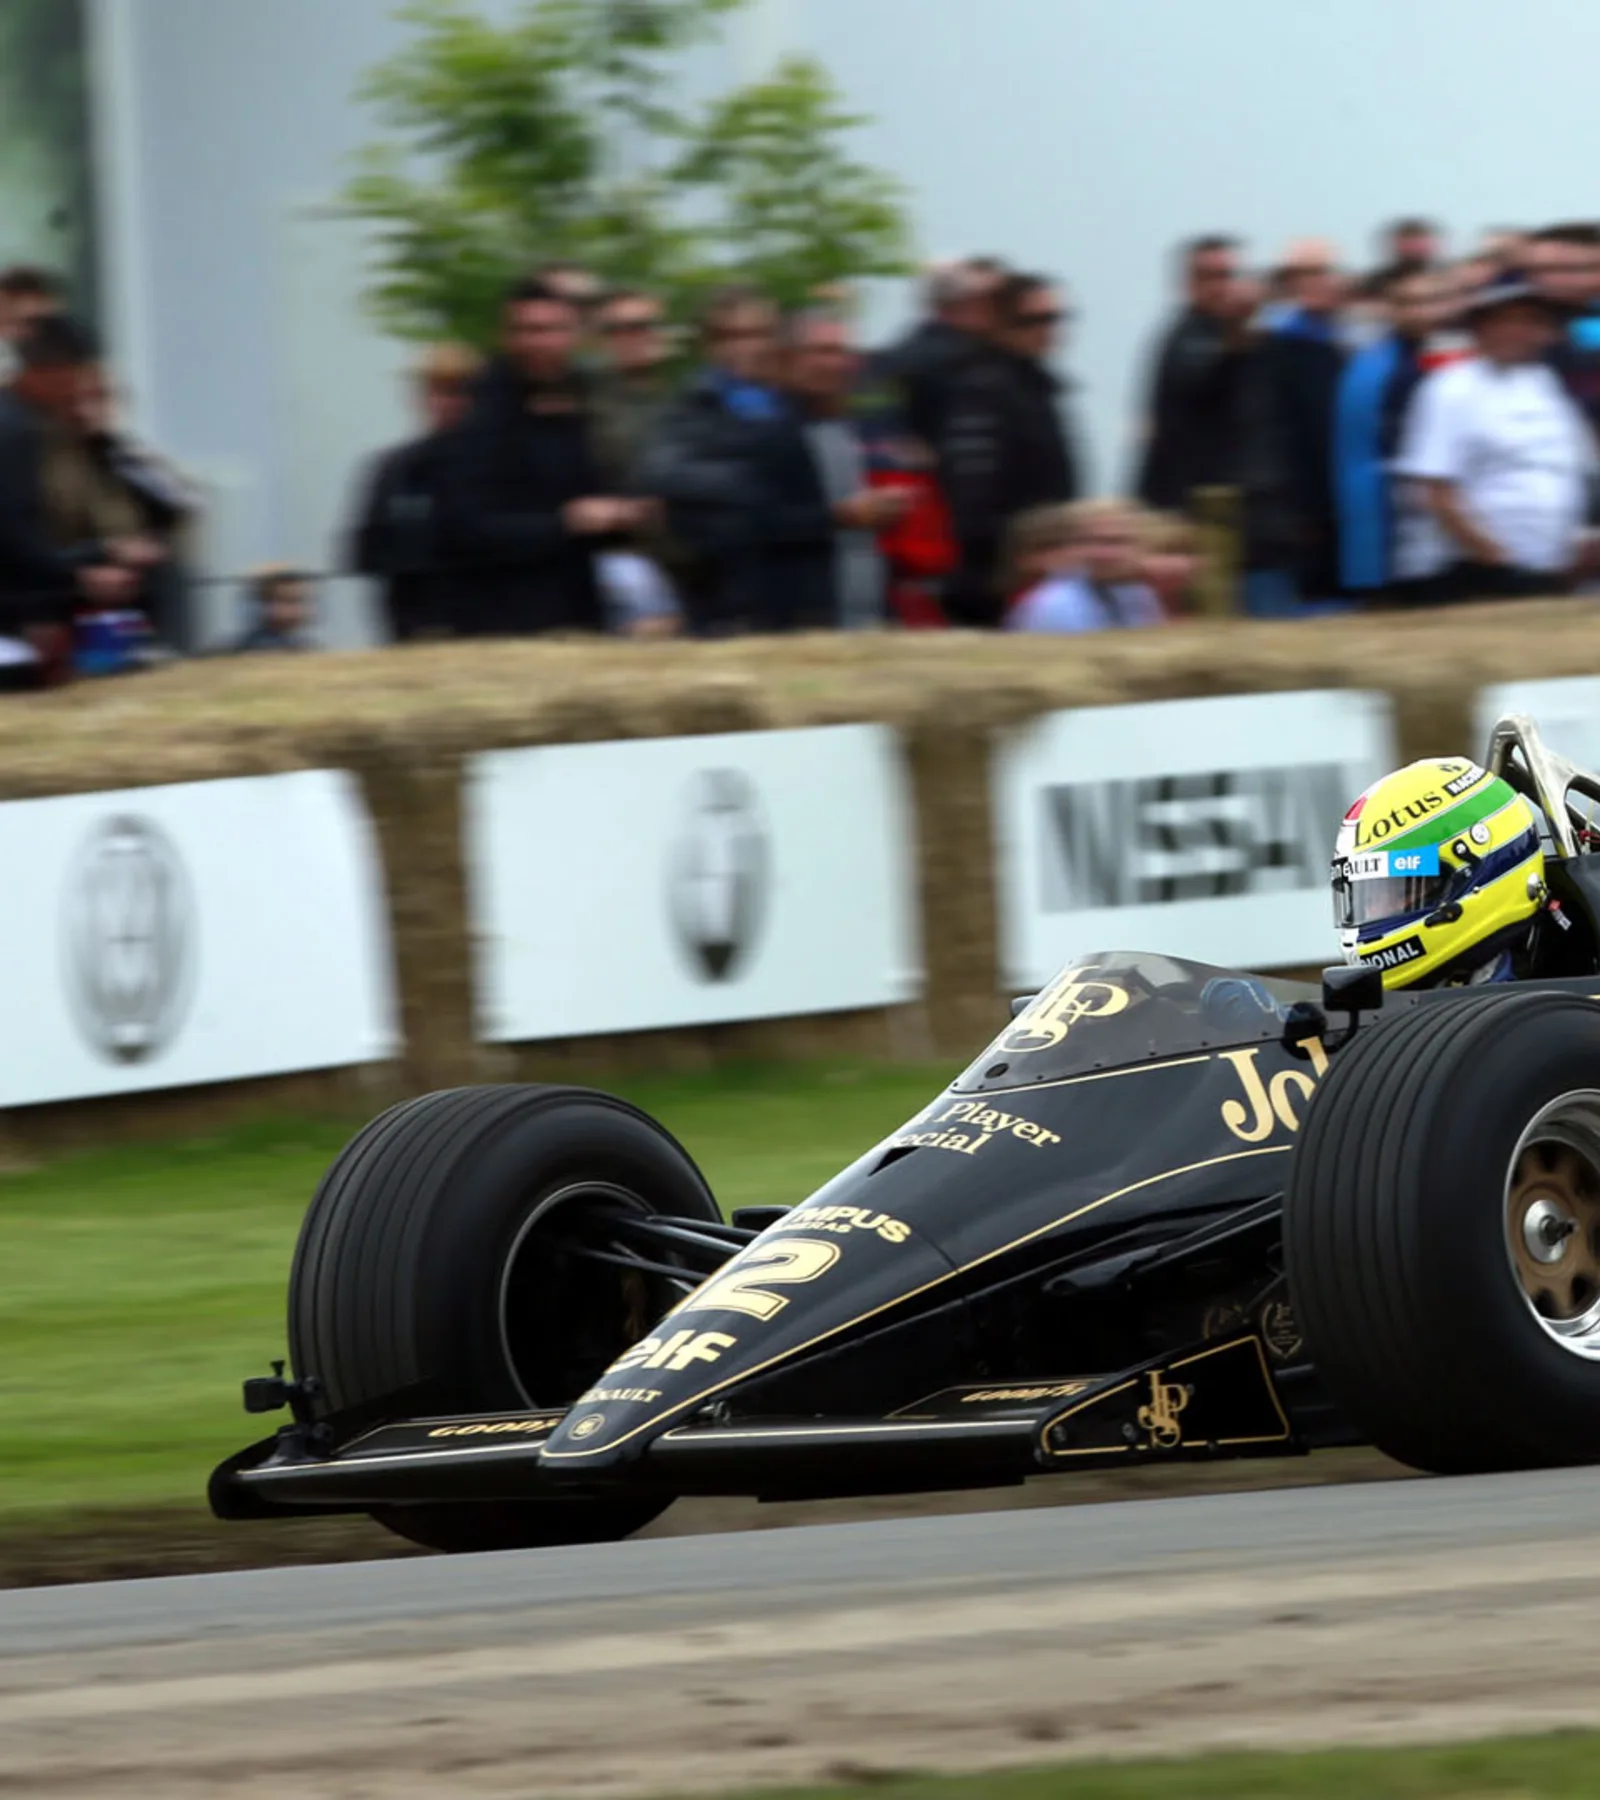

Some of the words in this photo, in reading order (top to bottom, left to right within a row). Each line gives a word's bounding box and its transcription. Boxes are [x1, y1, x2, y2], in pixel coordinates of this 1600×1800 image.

[1354, 790, 1443, 847] Lotus
[1394, 855, 1422, 871] elf
[934, 1101, 1062, 1148] Player
[688, 1237, 841, 1322] 2
